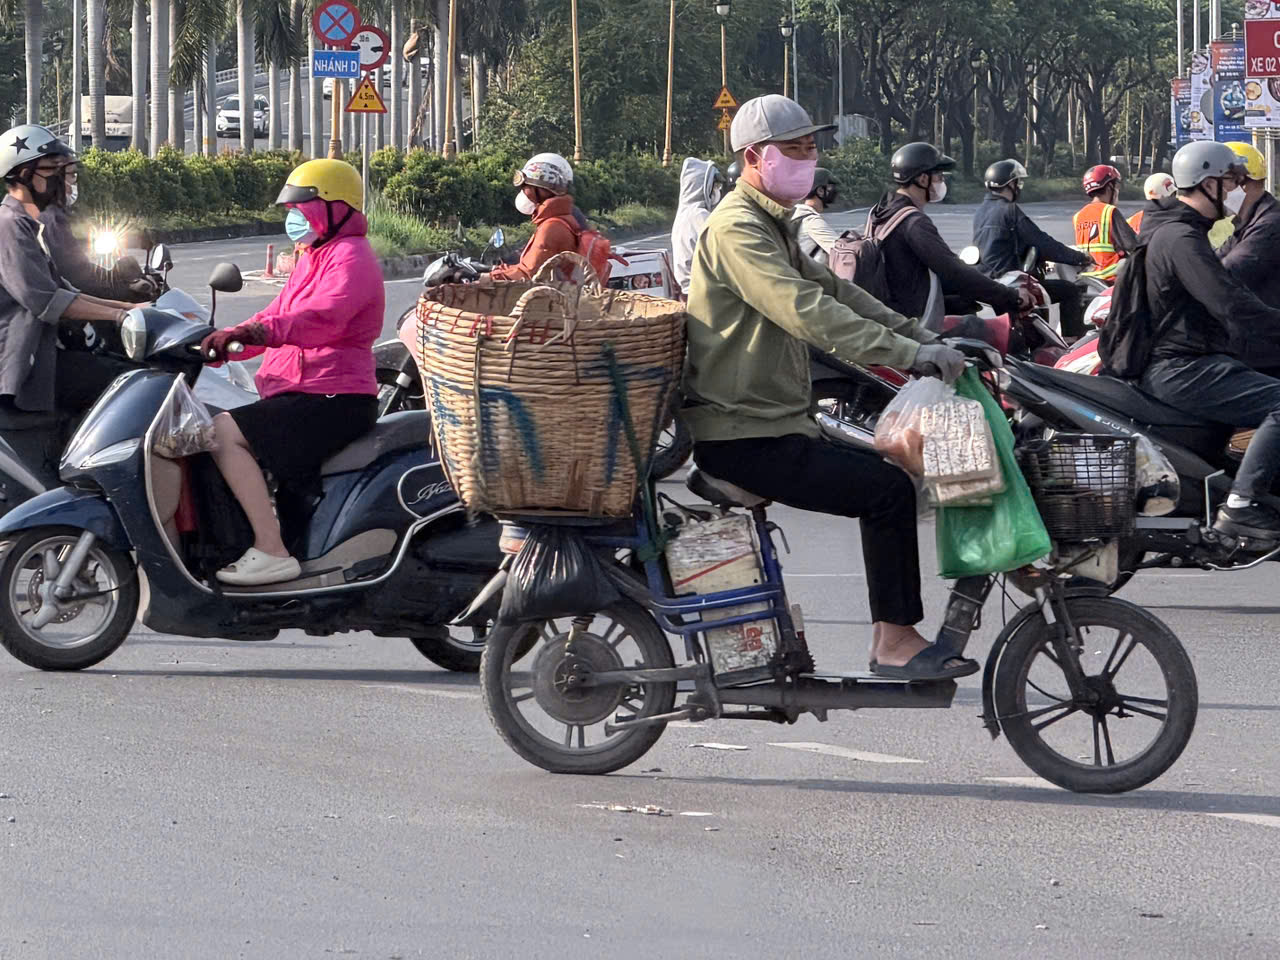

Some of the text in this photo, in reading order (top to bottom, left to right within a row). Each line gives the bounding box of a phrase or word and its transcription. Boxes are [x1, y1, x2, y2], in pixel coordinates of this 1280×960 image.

[314, 57, 358, 73] NHÁNH D
[1250, 57, 1277, 73] XE 02
